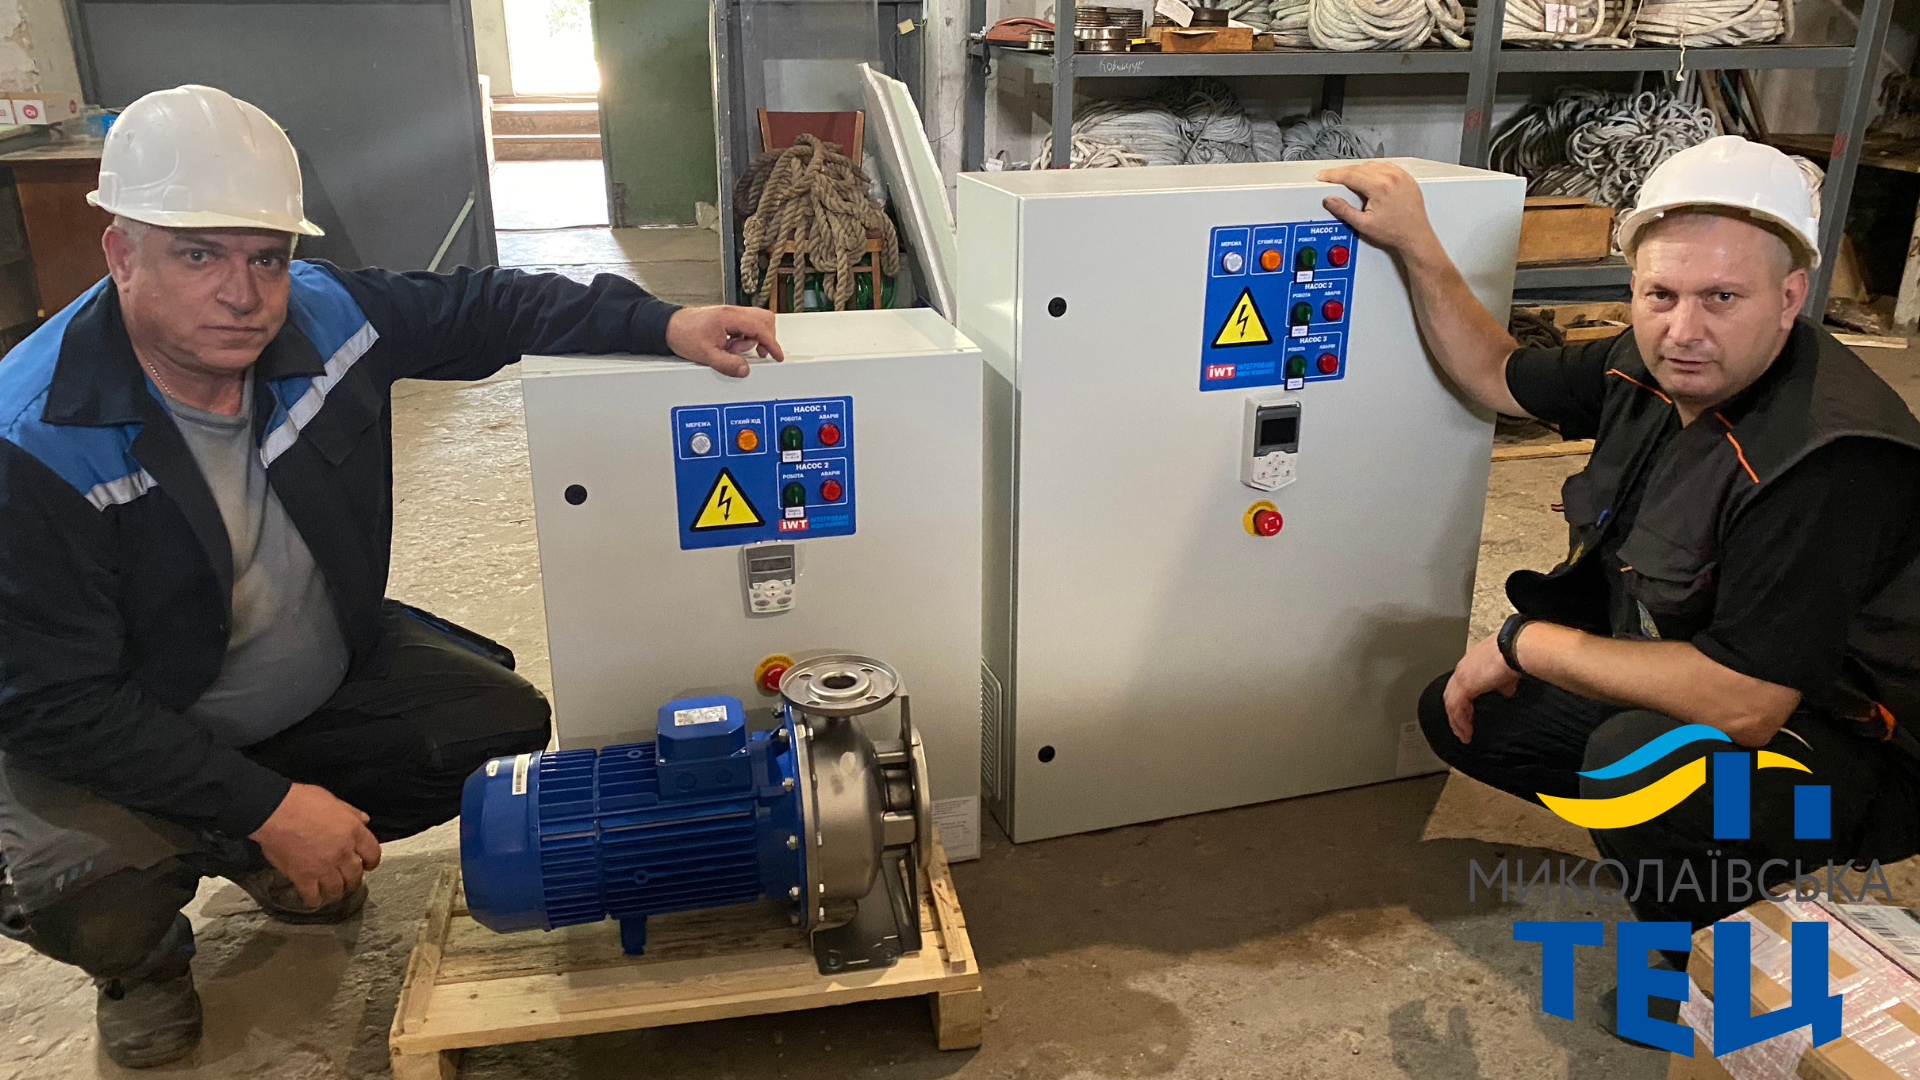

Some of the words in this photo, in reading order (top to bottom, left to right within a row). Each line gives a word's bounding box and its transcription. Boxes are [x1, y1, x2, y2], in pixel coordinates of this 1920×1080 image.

[1209, 365, 1235, 378] iWT
[730, 418, 750, 426] СУХИЙ
[795, 463, 822, 471] НАСОС
[782, 519, 808, 529] iWT
